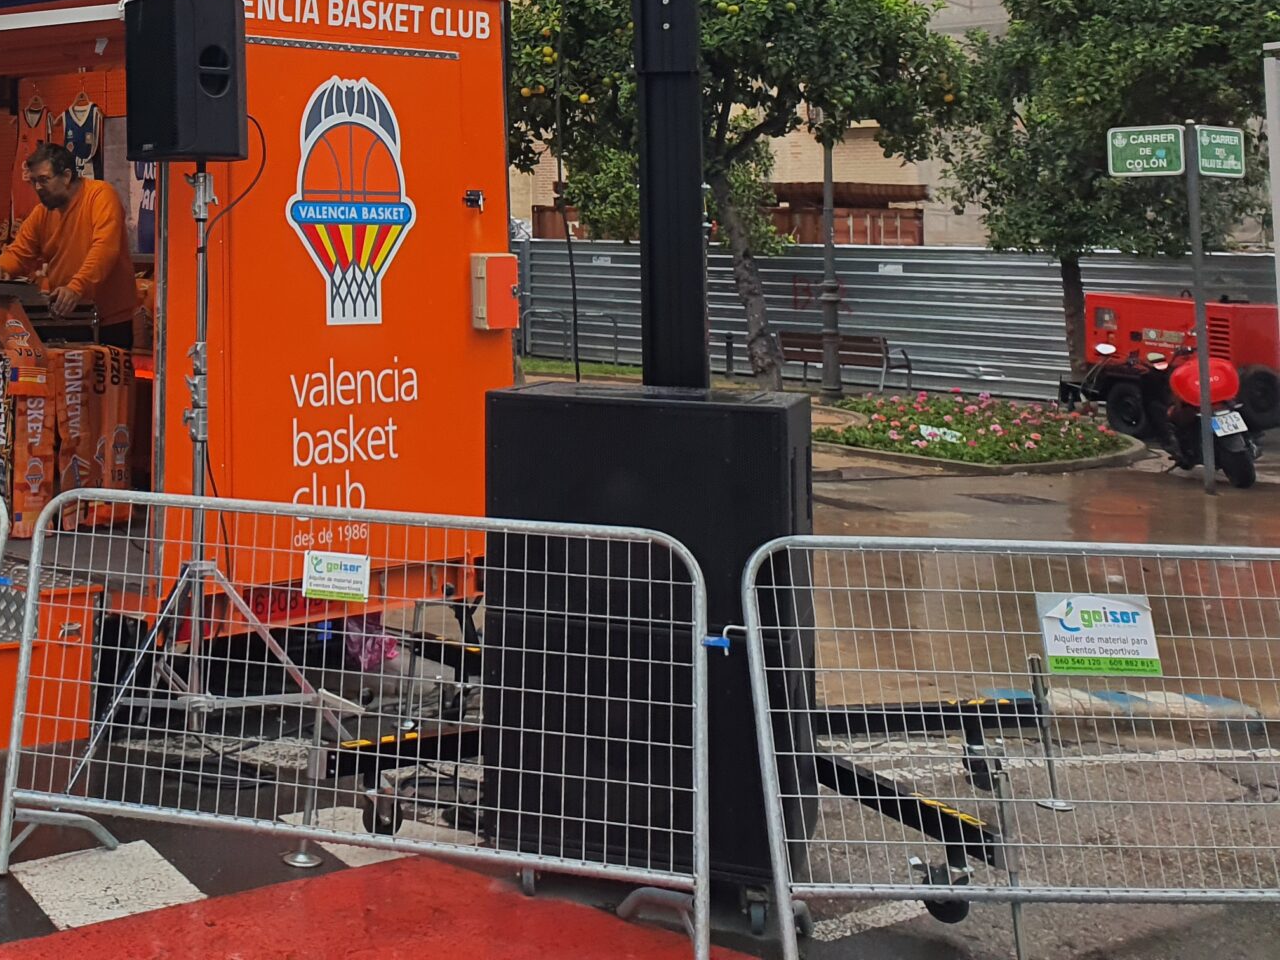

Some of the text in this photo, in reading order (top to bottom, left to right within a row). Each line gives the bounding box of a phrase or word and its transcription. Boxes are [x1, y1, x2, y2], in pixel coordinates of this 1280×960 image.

[430, 6, 491, 39] CLUB
[1129, 133, 1175, 144] CARRER
[1210, 134, 1239, 145] CARRER
[1139, 147, 1152, 155] DE
[1125, 156, 1168, 169] COLÓN
[298, 205, 405, 220] VALENCIA BASKET
[289, 355, 419, 408] valencia
[64, 349, 84, 440] VALENCIA
[292, 413, 399, 468] basket
[292, 469, 366, 521] club
[294, 523, 368, 547] des de 1986
[1053, 634, 1148, 646] Alquiler de material para
[1065, 645, 1140, 656] Eventos Deportivos
